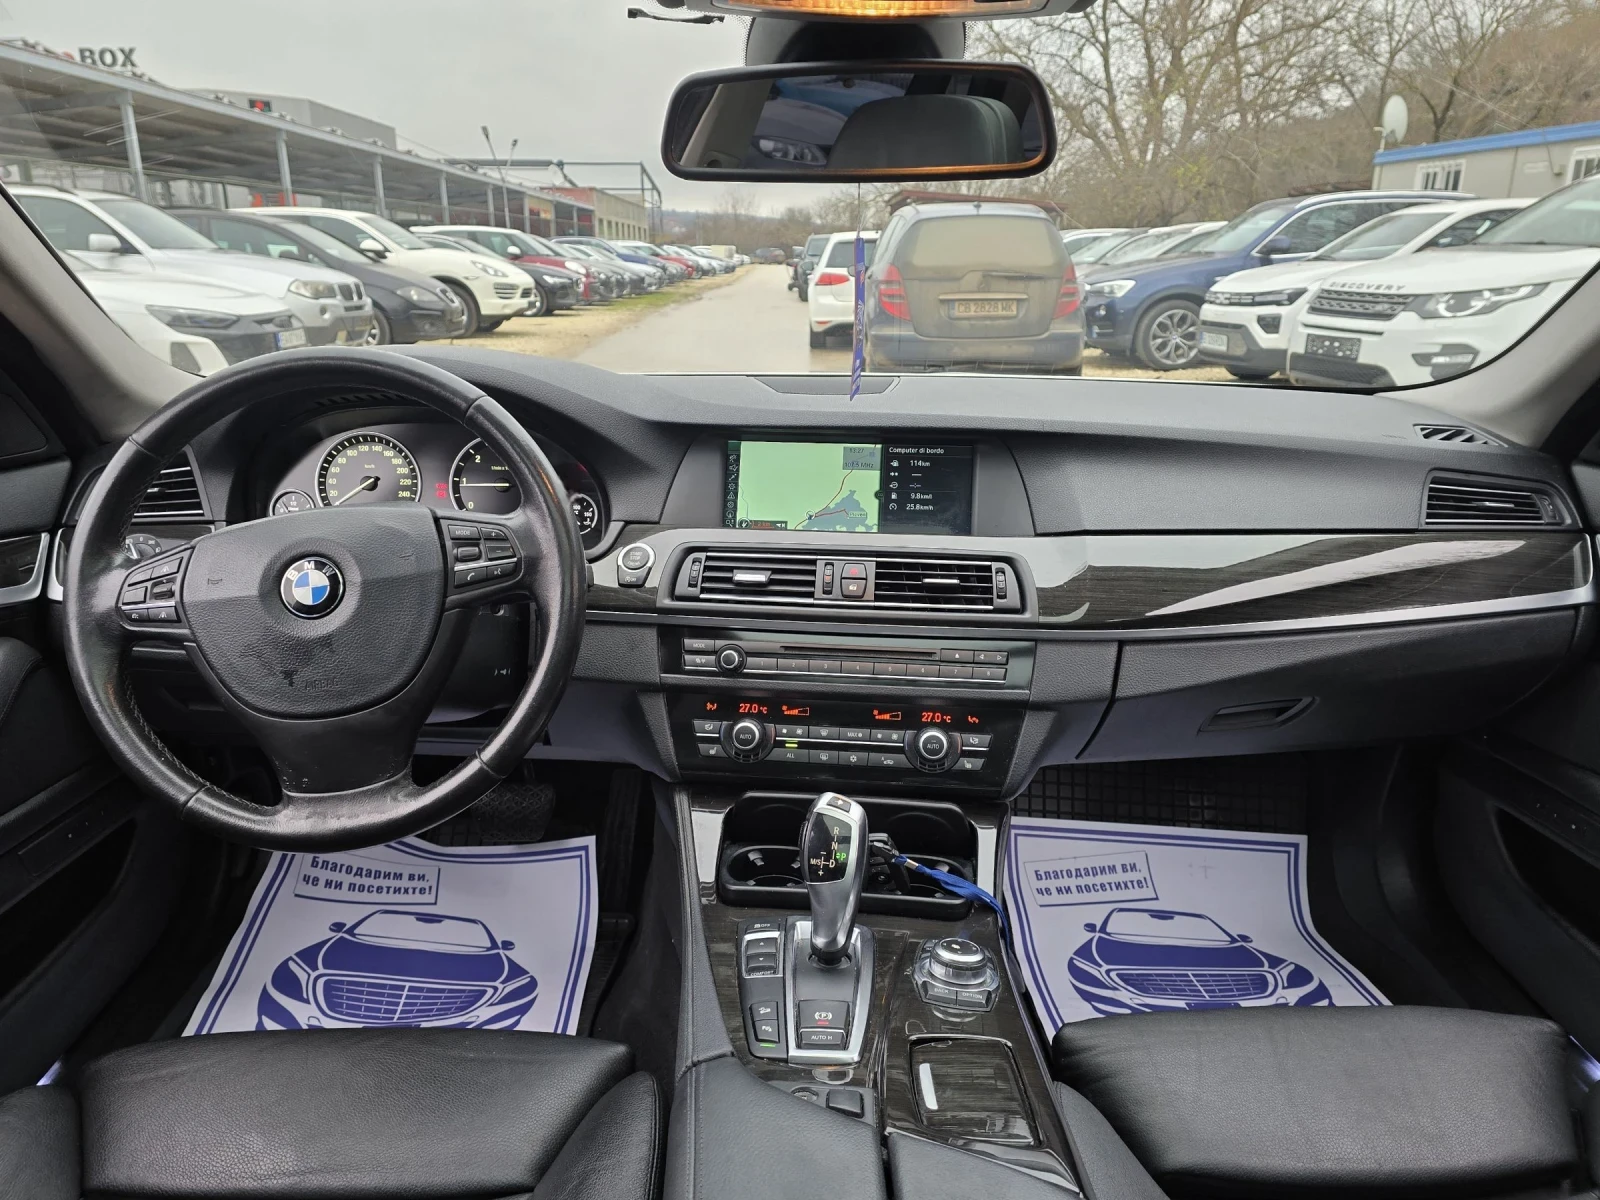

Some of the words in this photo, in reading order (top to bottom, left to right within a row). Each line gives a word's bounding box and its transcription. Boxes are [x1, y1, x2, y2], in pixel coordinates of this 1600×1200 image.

[78, 47, 137, 67] BOX
[1329, 281, 1406, 291] DISCOVERY
[286, 560, 336, 580] BMW
[739, 704, 758, 713] 27.0
[921, 712, 941, 723] 27.0
[833, 826, 840, 835] R
[831, 841, 838, 850] N
[810, 858, 821, 866] M/S
[841, 853, 847, 861] P
[310, 855, 403, 881] Благодарим
[407, 873, 430, 882] ви,
[829, 859, 836, 868] D
[1034, 864, 1118, 881] Благодарим
[1121, 862, 1141, 874] ви,
[302, 874, 320, 887] че
[324, 878, 343, 891] ни
[347, 882, 432, 895] посетихте!
[1036, 886, 1052, 896] че
[1055, 884, 1073, 895] ни
[1075, 876, 1149, 894] посетихте!
